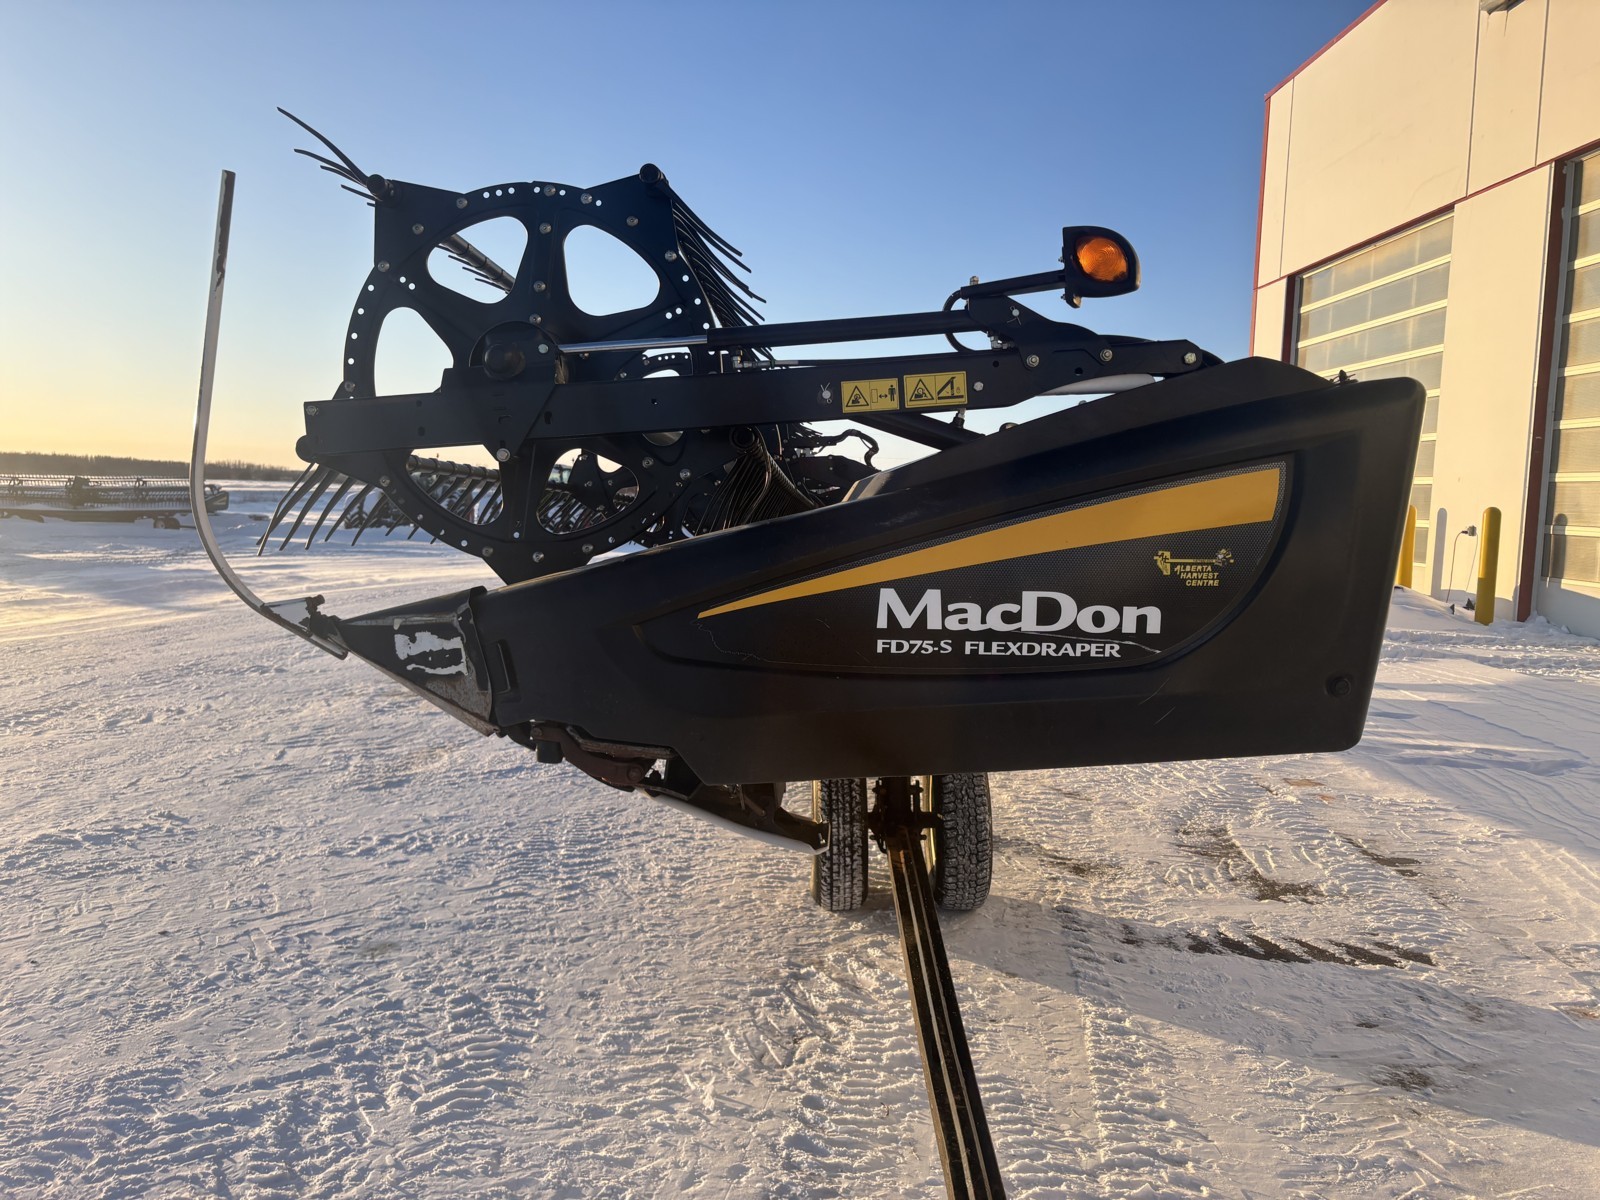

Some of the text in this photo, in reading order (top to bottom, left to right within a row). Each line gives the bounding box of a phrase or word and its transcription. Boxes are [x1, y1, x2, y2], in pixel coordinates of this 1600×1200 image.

[1174, 565, 1212, 574] ALBERTA
[876, 587, 1162, 634] MacDon
[876, 639, 1121, 658] FD75-S FLEXDRAPER
